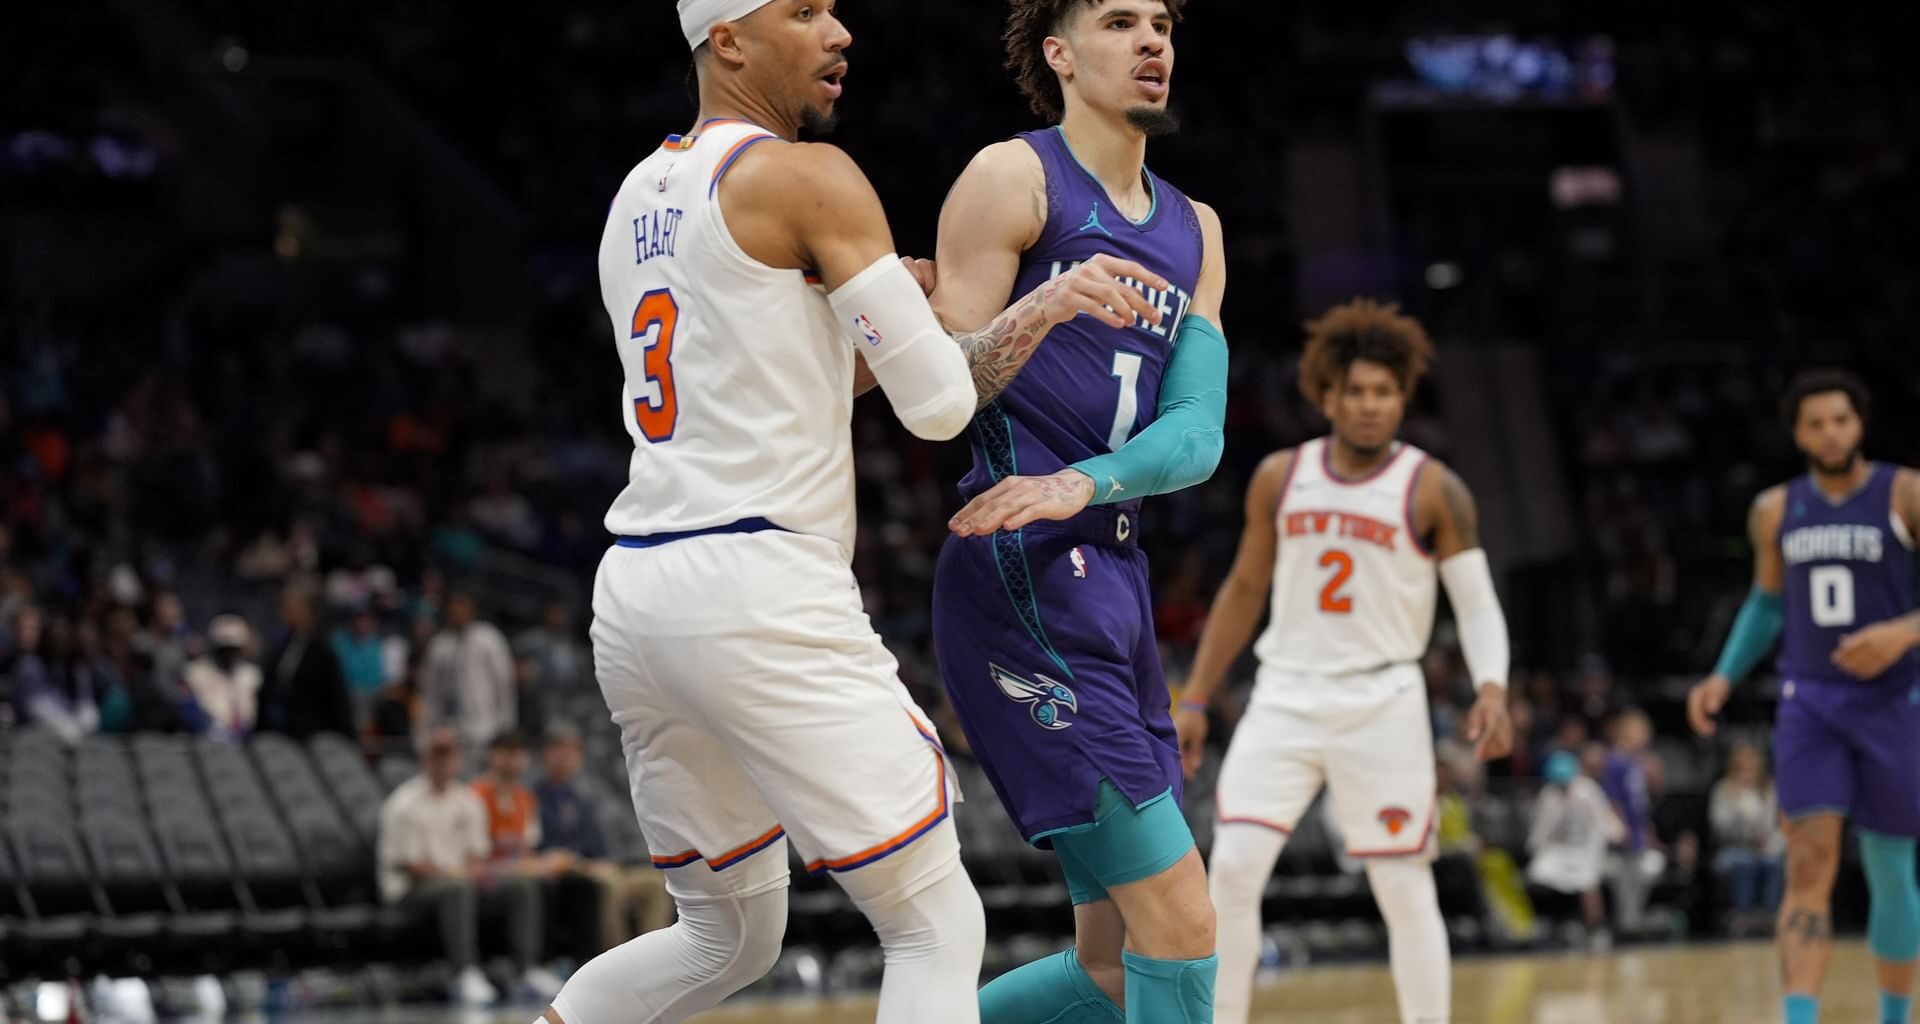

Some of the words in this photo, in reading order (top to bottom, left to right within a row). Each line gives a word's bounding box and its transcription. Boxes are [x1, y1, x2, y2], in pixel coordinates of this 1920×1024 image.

[633, 208, 683, 264] HART
[631, 287, 679, 444] 3
[1108, 351, 1142, 452] 1
[1286, 510, 1331, 536] NEW
[1336, 511, 1398, 551] YORK
[1319, 550, 1354, 613] 2
[1809, 565, 1855, 627] 0
